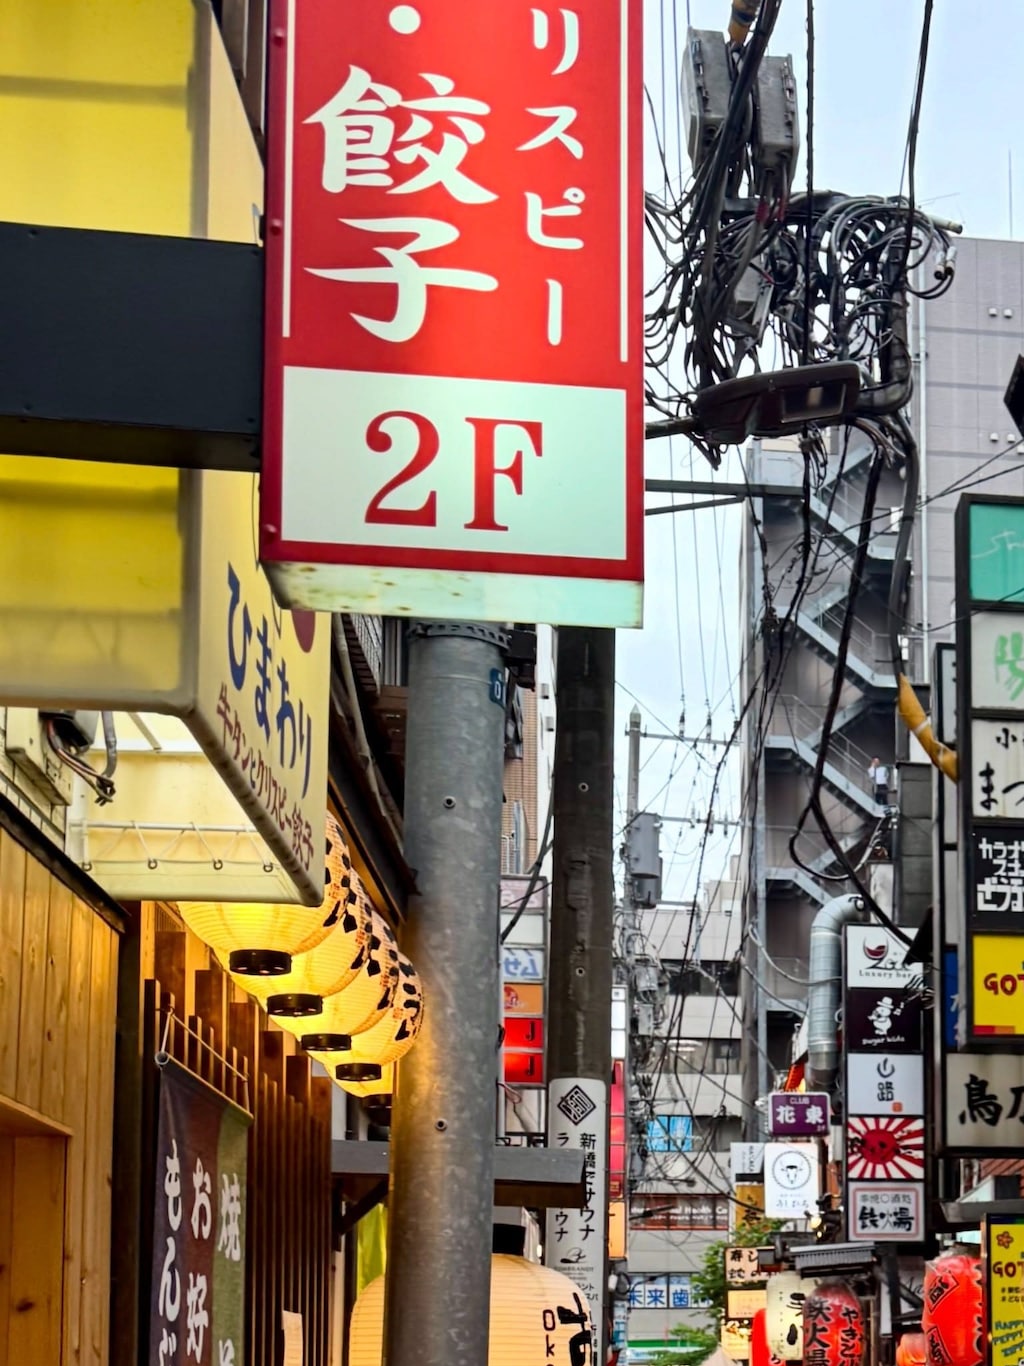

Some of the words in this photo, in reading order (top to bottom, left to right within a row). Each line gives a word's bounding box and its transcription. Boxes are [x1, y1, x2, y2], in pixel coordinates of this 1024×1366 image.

[364, 411, 543, 532] 2F
[227, 561, 312, 800] ひまわり
[216, 683, 314, 872] 牛タンとクリスピー餃子
